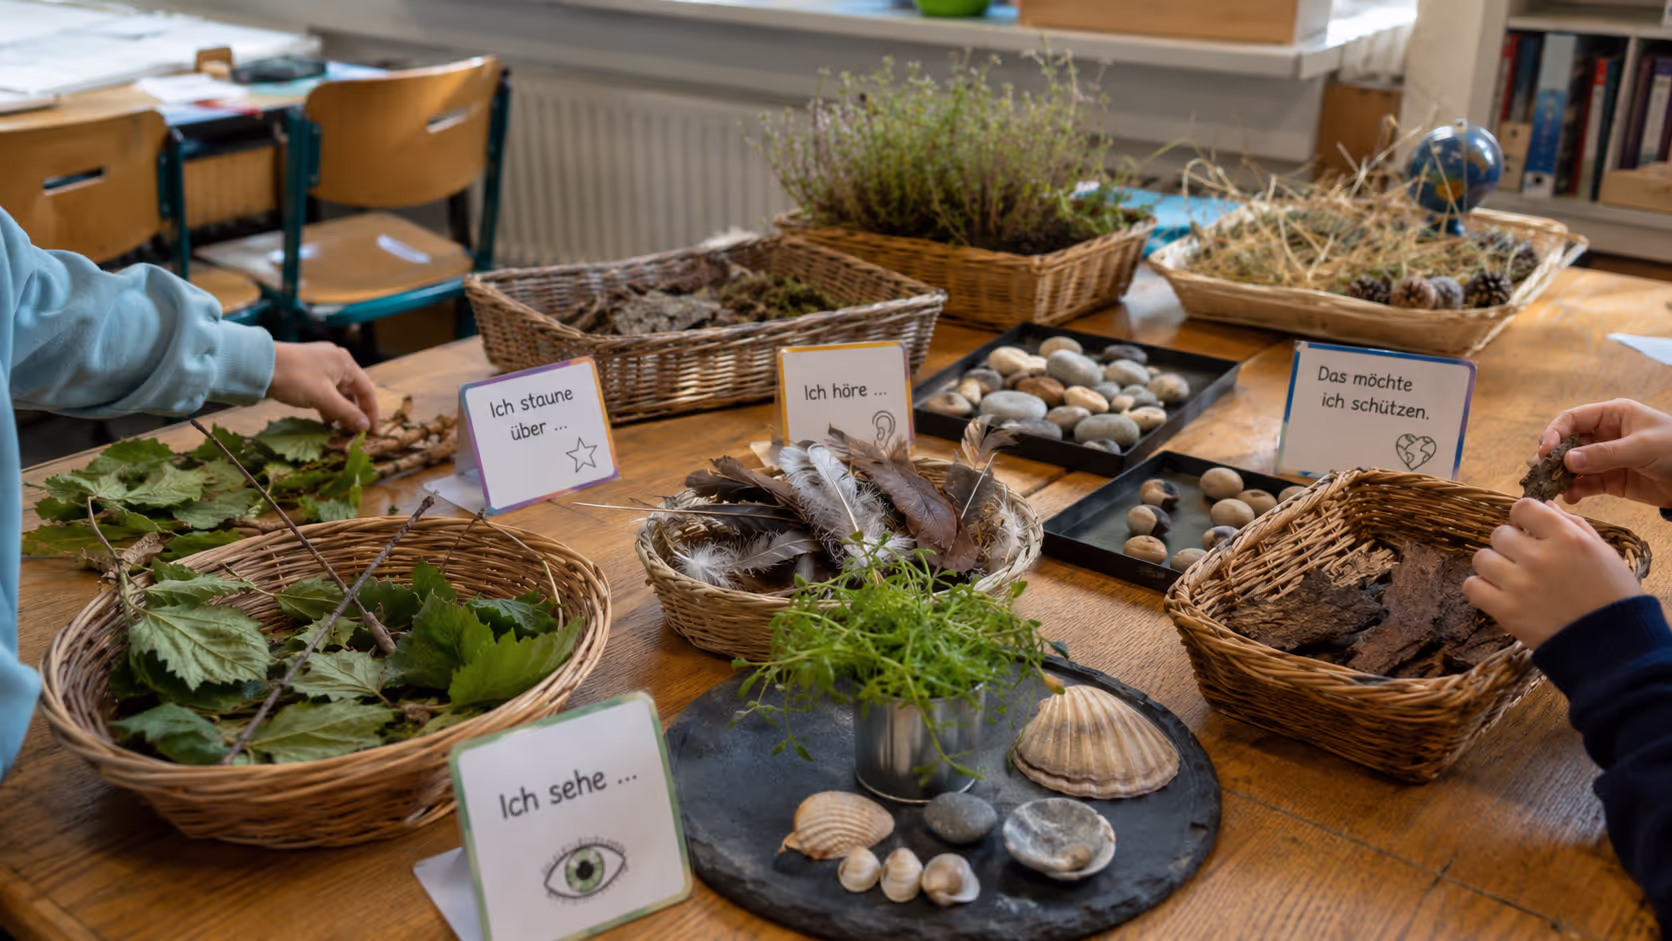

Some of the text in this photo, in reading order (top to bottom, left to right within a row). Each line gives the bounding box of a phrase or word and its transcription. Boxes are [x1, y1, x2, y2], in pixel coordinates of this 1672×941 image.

[804, 383, 827, 401] Ich
[832, 382, 868, 399] höre
[1317, 365, 1413, 392] Das möchte
[489, 389, 574, 418] Ich staune
[1321, 392, 1430, 421] ich schützen.
[510, 421, 547, 441] über
[499, 769, 637, 819] Ich sehe ...
